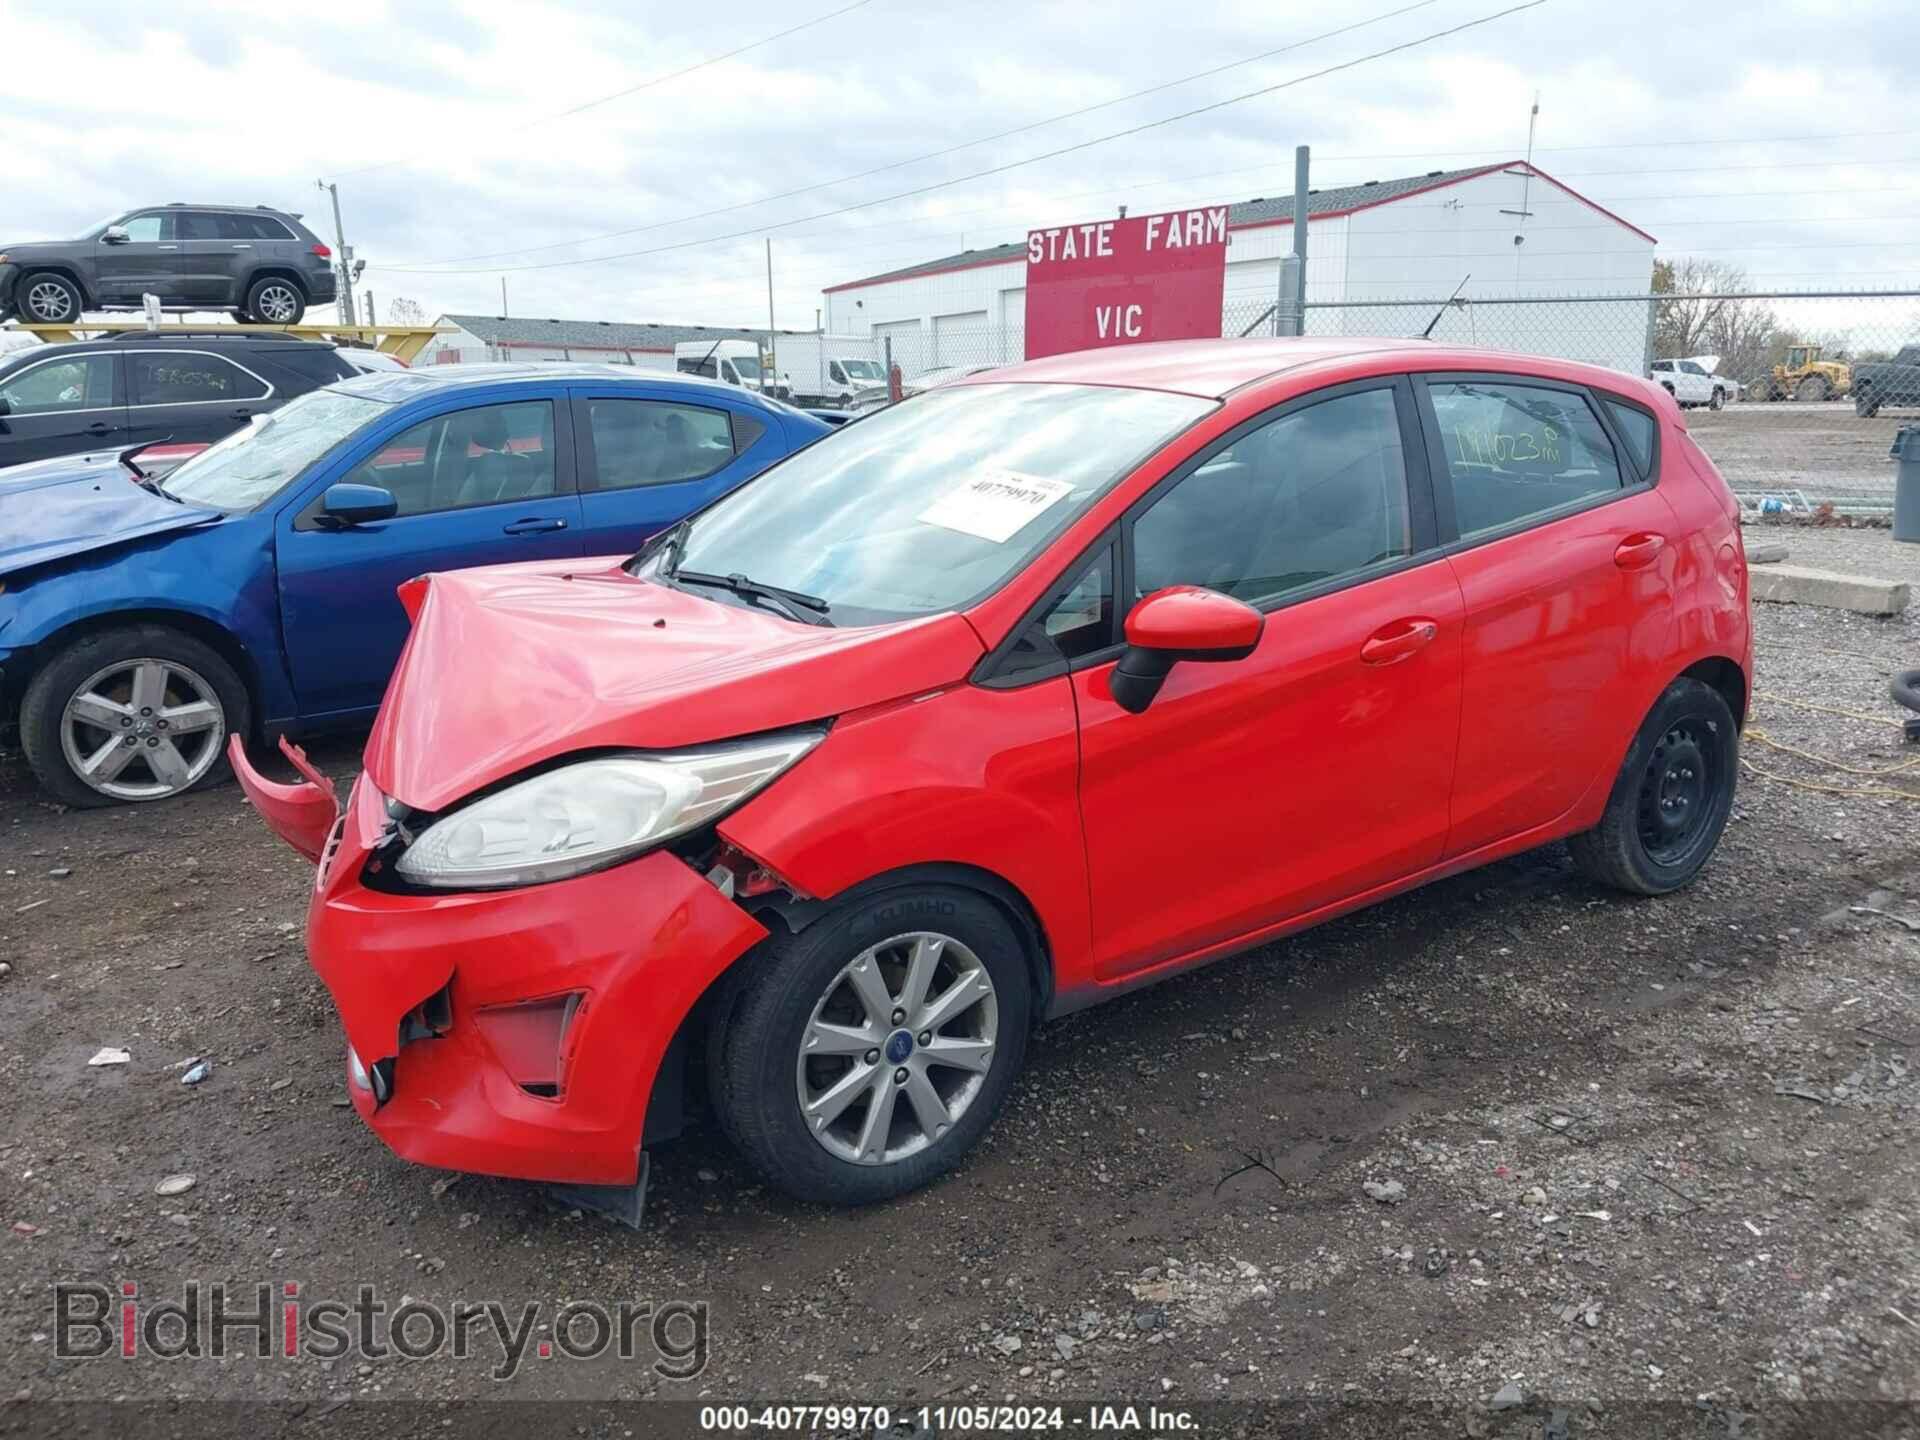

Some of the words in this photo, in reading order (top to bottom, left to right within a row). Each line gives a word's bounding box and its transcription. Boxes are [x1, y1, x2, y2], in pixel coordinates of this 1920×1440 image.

[1027, 222, 1114, 264] STATE
[1145, 206, 1227, 251] FARM
[1095, 304, 1142, 339] VIC
